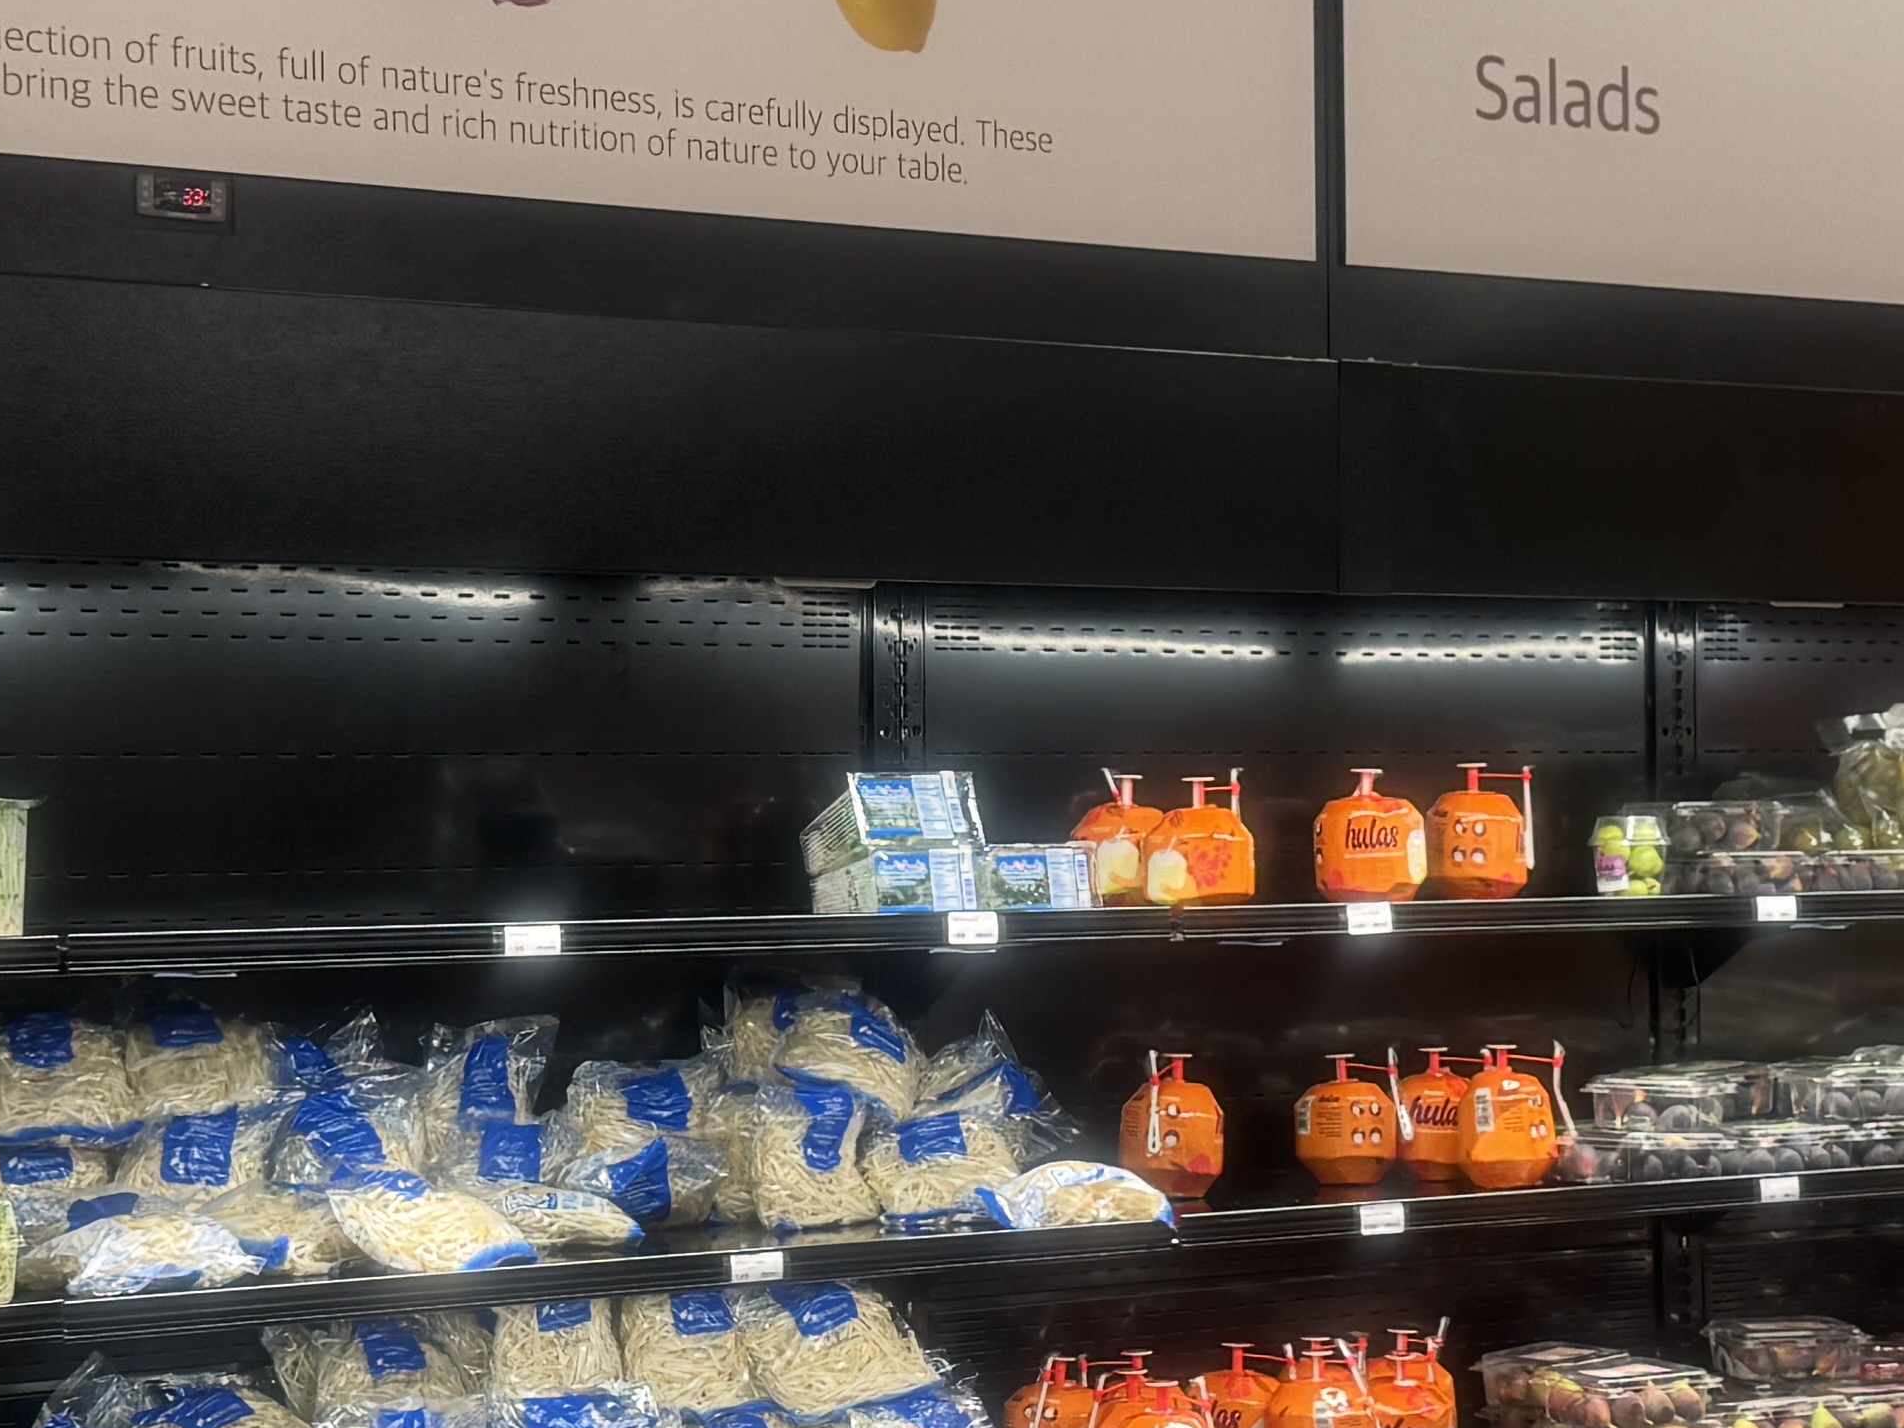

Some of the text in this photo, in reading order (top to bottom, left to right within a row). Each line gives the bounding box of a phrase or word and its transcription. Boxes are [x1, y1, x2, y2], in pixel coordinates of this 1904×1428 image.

[3, 62, 91, 109] bring
[104, 74, 159, 110] the
[171, 86, 270, 120] sweet
[283, 94, 361, 129] taste
[373, 104, 430, 136] and
[442, 109, 496, 141] rich
[510, 120, 636, 154] nutrition
[647, 129, 676, 157] of
[687, 136, 777, 167] nature
[789, 142, 816, 171] to
[826, 151, 886, 178] your
[898, 152, 967, 185] table.
[125, 33, 158, 65] of
[171, 36, 263, 81] fruits,
[278, 48, 325, 83] full
[338, 56, 370, 86] of
[382, 64, 503, 101] nature's
[515, 72, 662, 120] freshness,
[674, 88, 694, 119] is
[705, 97, 822, 137] carefully
[833, 105, 965, 147] displayed.
[975, 119, 1053, 154] These
[1475, 55, 1660, 135] Salads
[1346, 816, 1400, 849] hulas
[1410, 1095, 1459, 1128] hula
